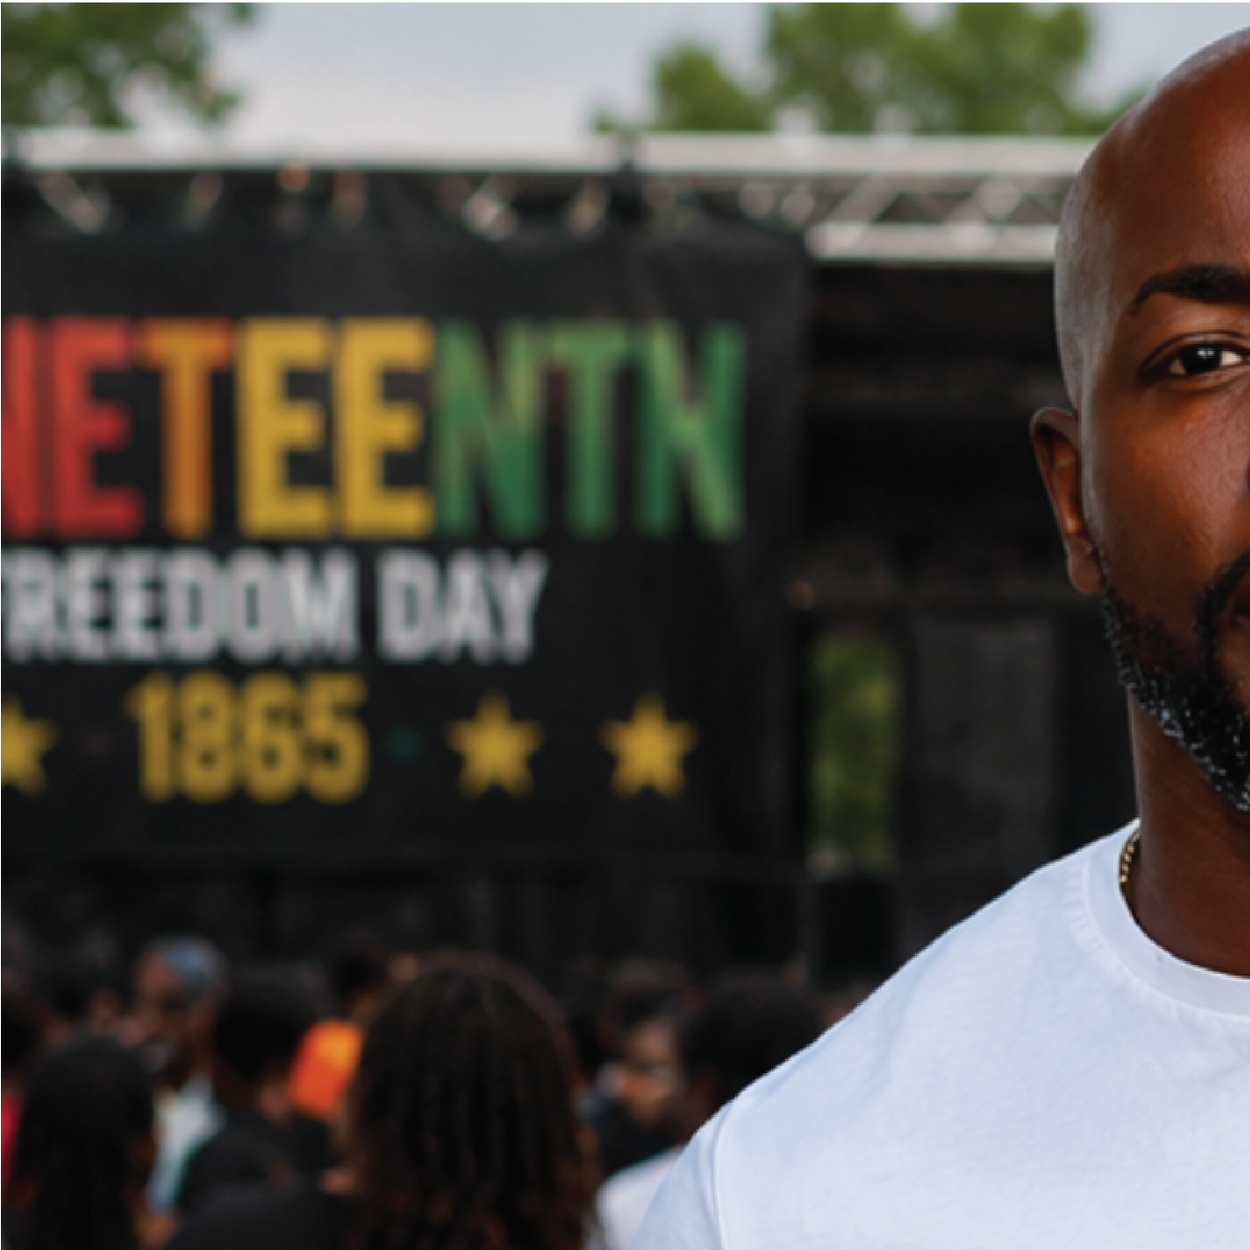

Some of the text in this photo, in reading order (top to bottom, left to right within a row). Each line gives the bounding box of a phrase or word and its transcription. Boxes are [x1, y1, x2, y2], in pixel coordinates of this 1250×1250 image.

[1, 548, 549, 664] REEDOM DAY
[127, 673, 369, 802] 1865
